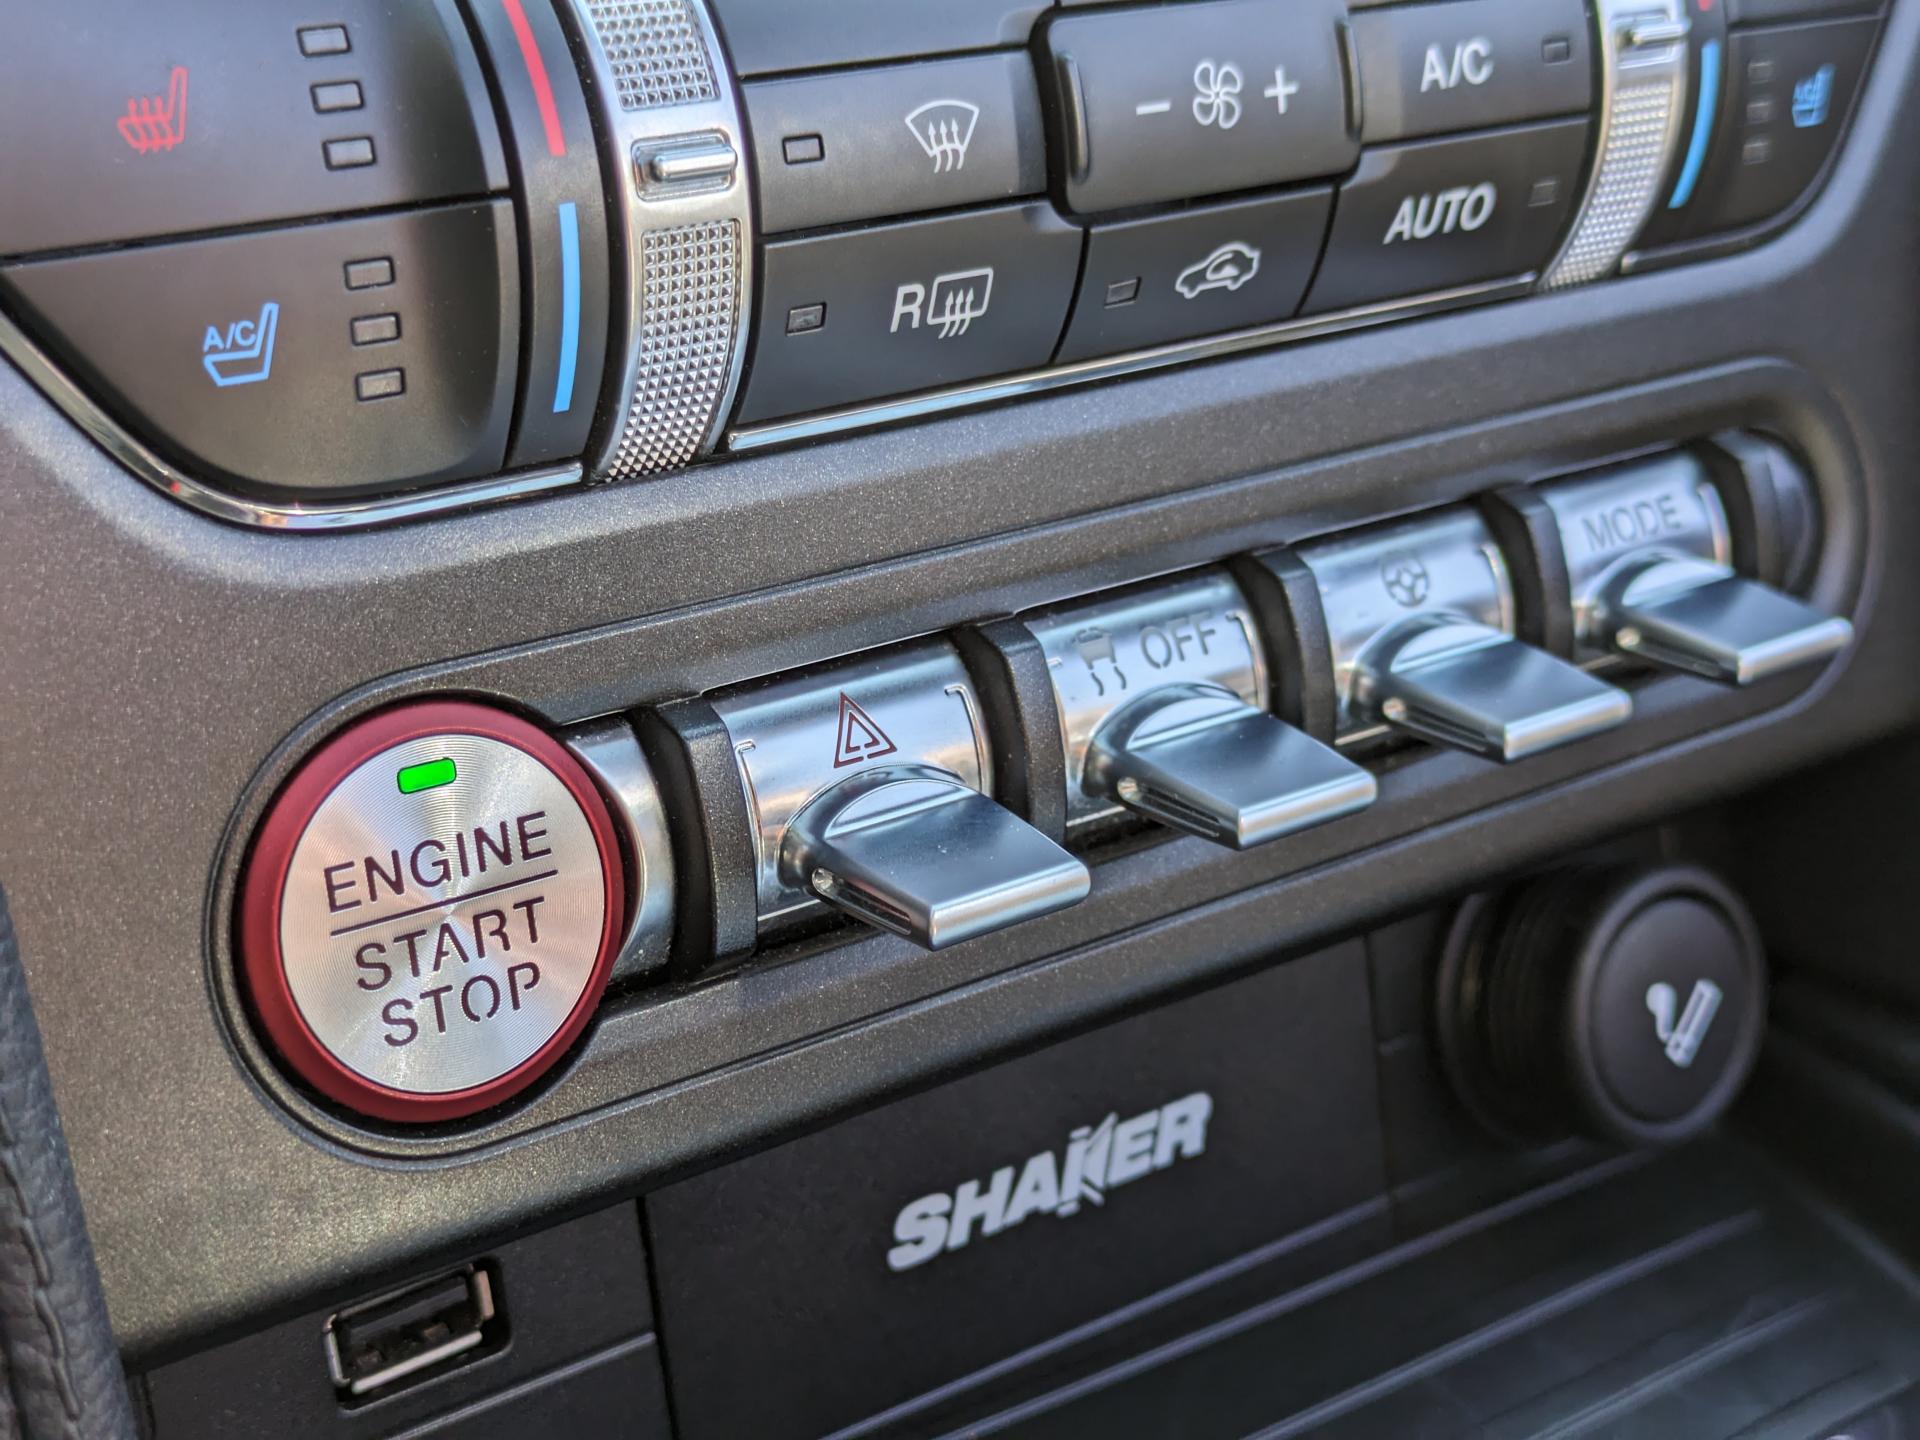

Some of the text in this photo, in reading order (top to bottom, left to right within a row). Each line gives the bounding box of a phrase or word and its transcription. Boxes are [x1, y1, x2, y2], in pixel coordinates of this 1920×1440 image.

[1420, 38, 1494, 92] A/C
[1383, 182, 1496, 244] AUTO
[203, 321, 256, 350] A/C
[890, 286, 924, 332] R
[1582, 495, 1681, 550] MODE
[1141, 614, 1216, 668] OFF
[325, 811, 553, 914] ENGINE
[355, 896, 545, 992] START
[382, 961, 541, 1047] STOP
[887, 1091, 1213, 1271] SHAKER
